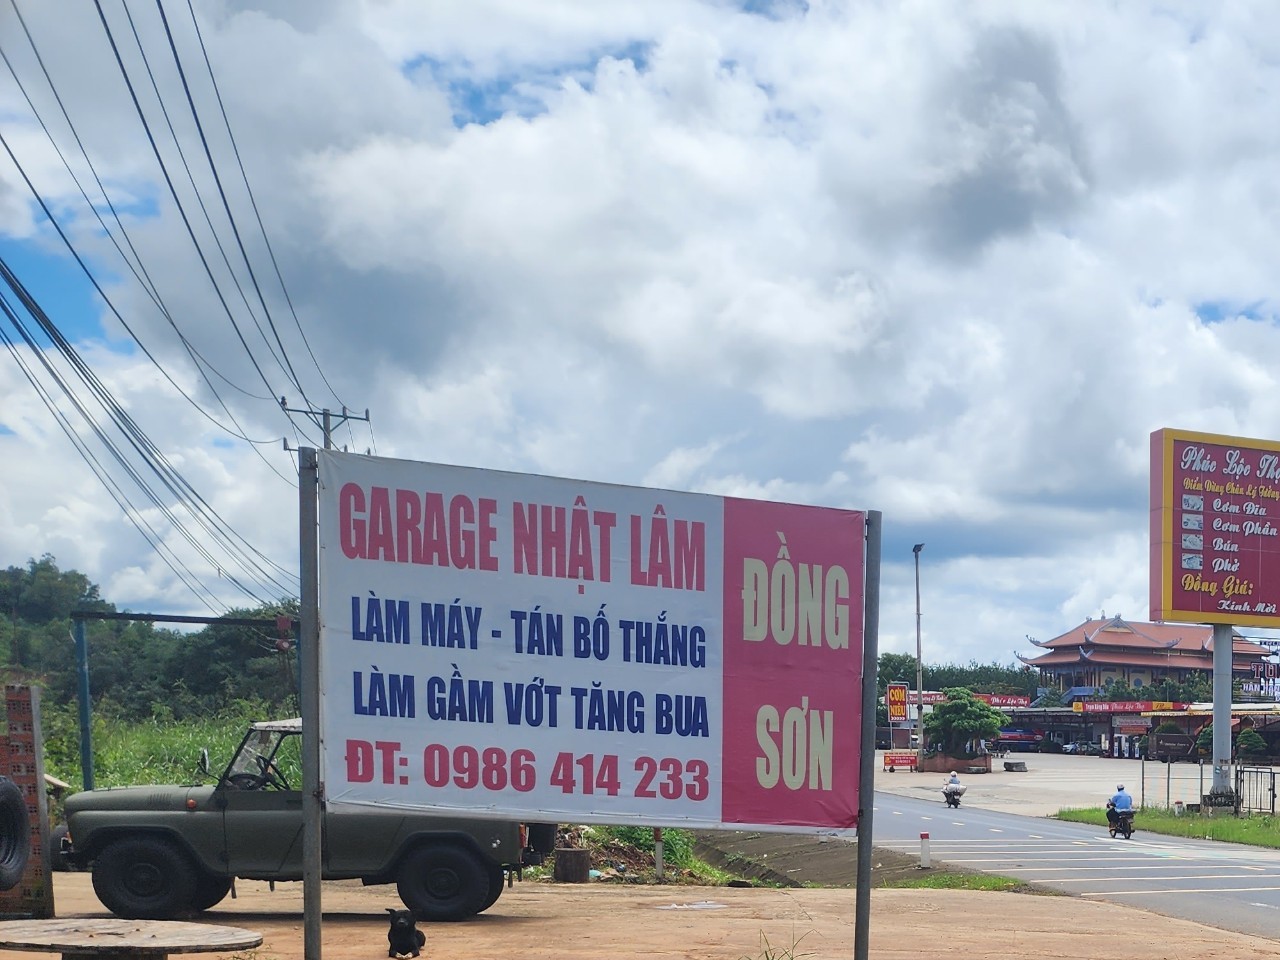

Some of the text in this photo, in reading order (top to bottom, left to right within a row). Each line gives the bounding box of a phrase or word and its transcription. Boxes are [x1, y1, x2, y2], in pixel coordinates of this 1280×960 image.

[1181, 446, 1217, 472] Phúc
[1223, 450, 1251, 480] Lộc
[1212, 498, 1240, 514] Cơm
[339, 482, 706, 595] GARAGE NHẬT LÂM
[1212, 518, 1278, 537] Cơm Phần
[1212, 538, 1239, 552] Bún
[1212, 557, 1240, 573] Phở
[741, 531, 850, 650] ĐỒNG
[1181, 573, 1254, 598] Đồng Giá:
[1252, 602, 1277, 614] Mời
[350, 590, 706, 668] LÀM MÁY - TÁN BỐ THẮNG
[352, 663, 710, 738] LÀM GẦM VỚT TĂNG BUA
[889, 688, 906, 702] CƠM
[755, 696, 834, 792] SƠN
[345, 738, 710, 802] ĐT: 0986 414 233
